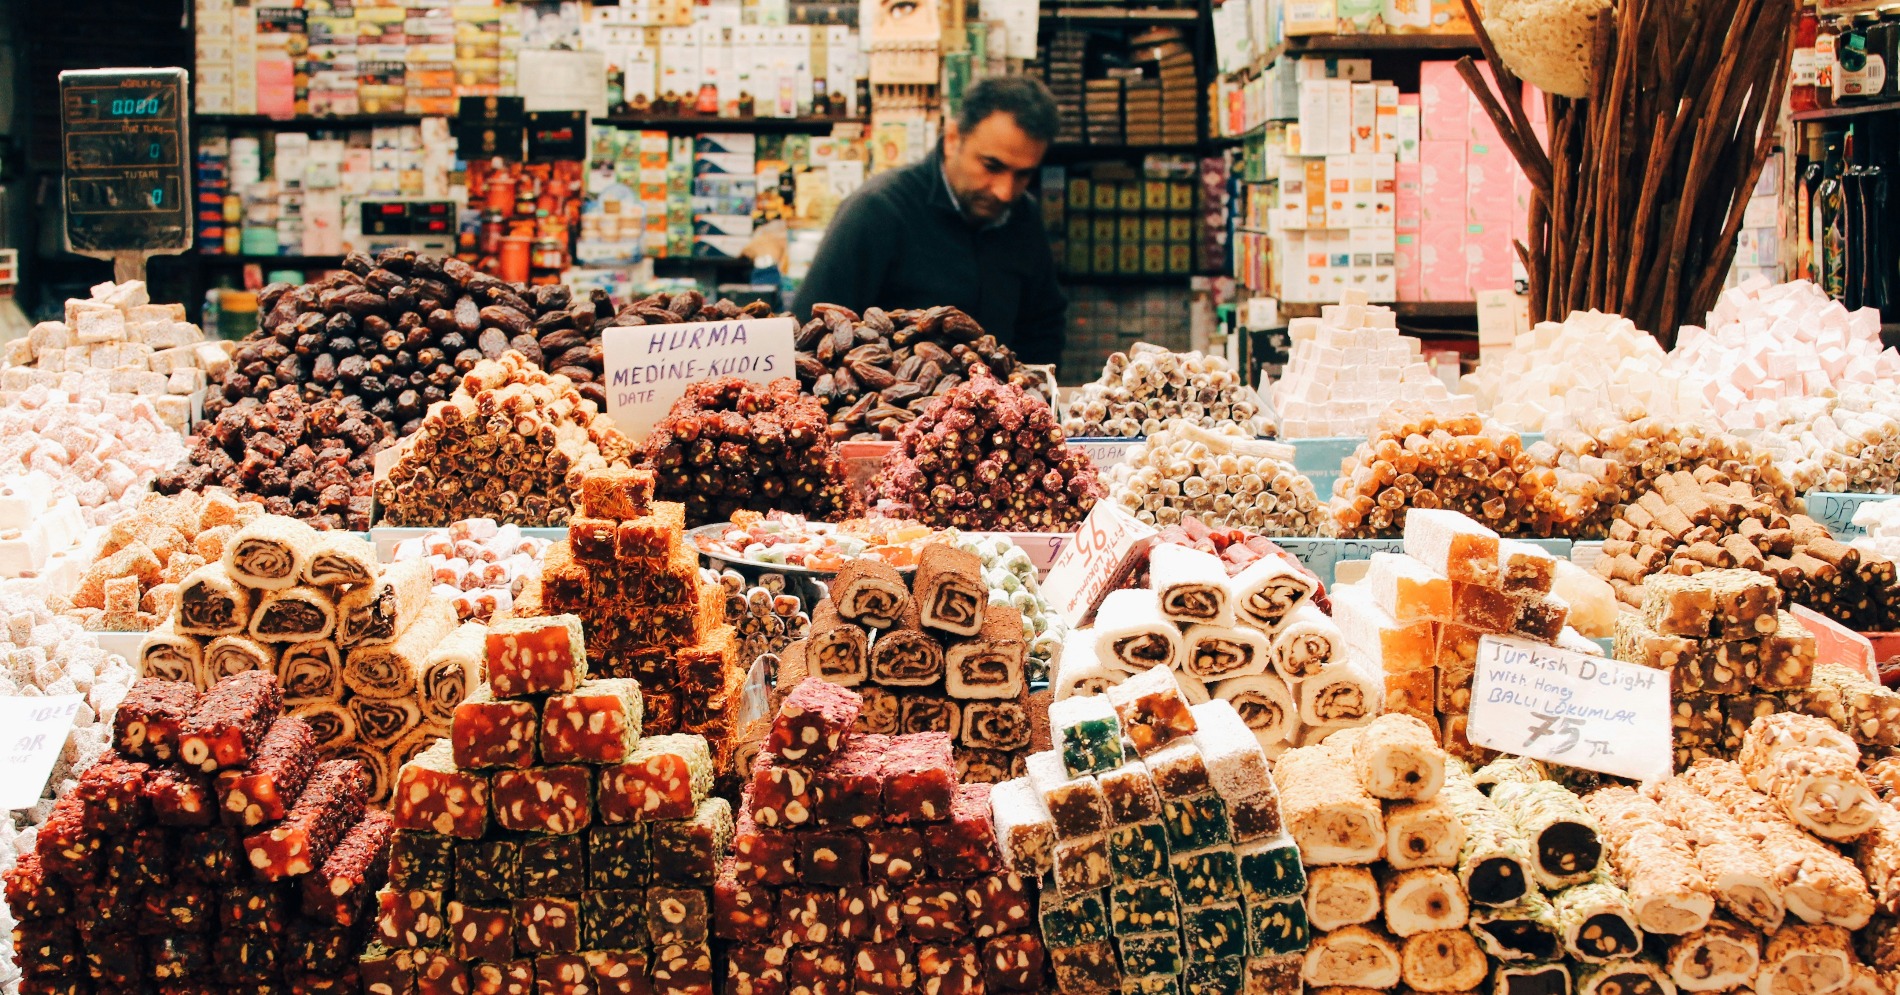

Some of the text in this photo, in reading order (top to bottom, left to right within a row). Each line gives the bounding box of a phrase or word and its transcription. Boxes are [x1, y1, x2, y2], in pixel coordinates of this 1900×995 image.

[149, 143, 159, 158] 0
[151, 189, 162, 204] 0
[648, 324, 747, 354] HURMA
[618, 389, 655, 407] DATE
[1086, 552, 1120, 606] ANTEP
[1486, 639, 1656, 691] Turkish Delight
[1487, 687, 1538, 707] BALLI
[1534, 677, 1574, 700] Honey
[1522, 711, 1586, 754] 75
